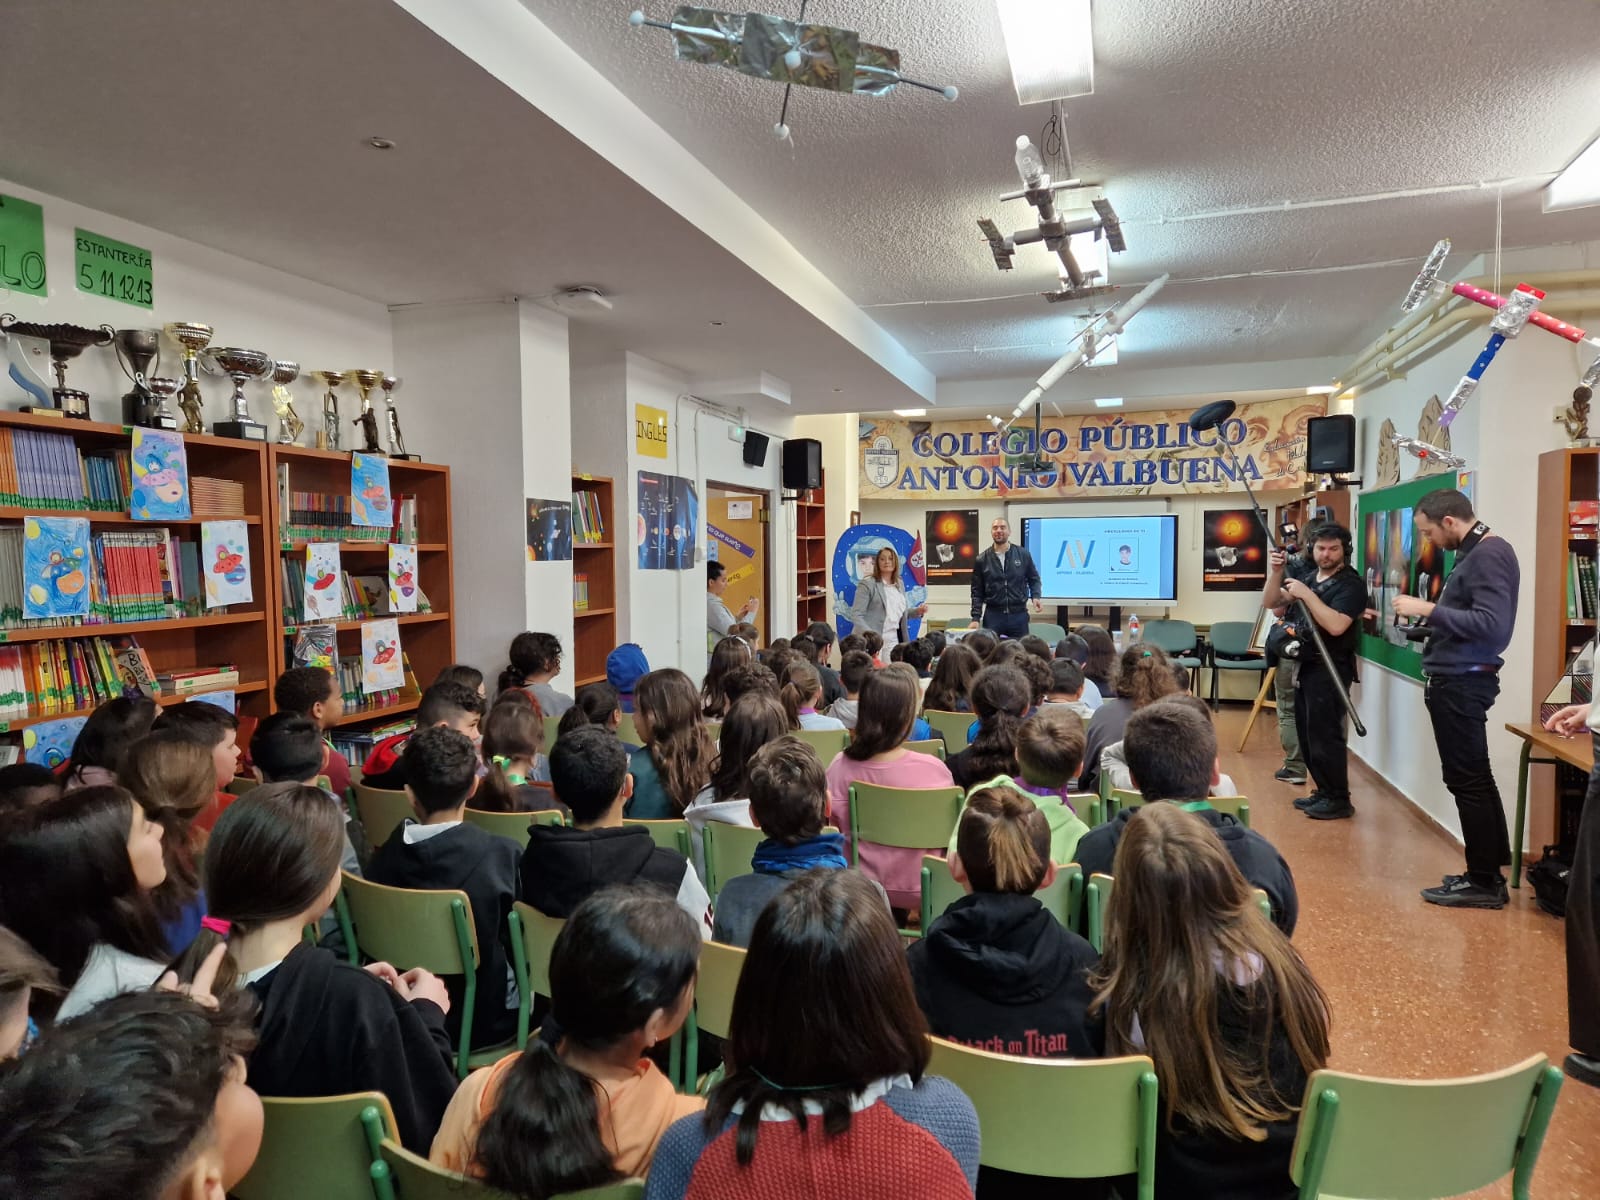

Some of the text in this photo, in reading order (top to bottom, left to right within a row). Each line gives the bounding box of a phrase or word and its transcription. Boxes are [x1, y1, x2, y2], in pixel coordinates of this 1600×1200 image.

[76, 238, 152, 271] ESTANTERÍA
[80, 263, 94, 289] 5
[911, 416, 1248, 458] COLEGIO PÚBLICO
[1067, 453, 1264, 487] VALBUENA
[1008, 1040, 1023, 1054] on
[1023, 1029, 1068, 1057] Titan
